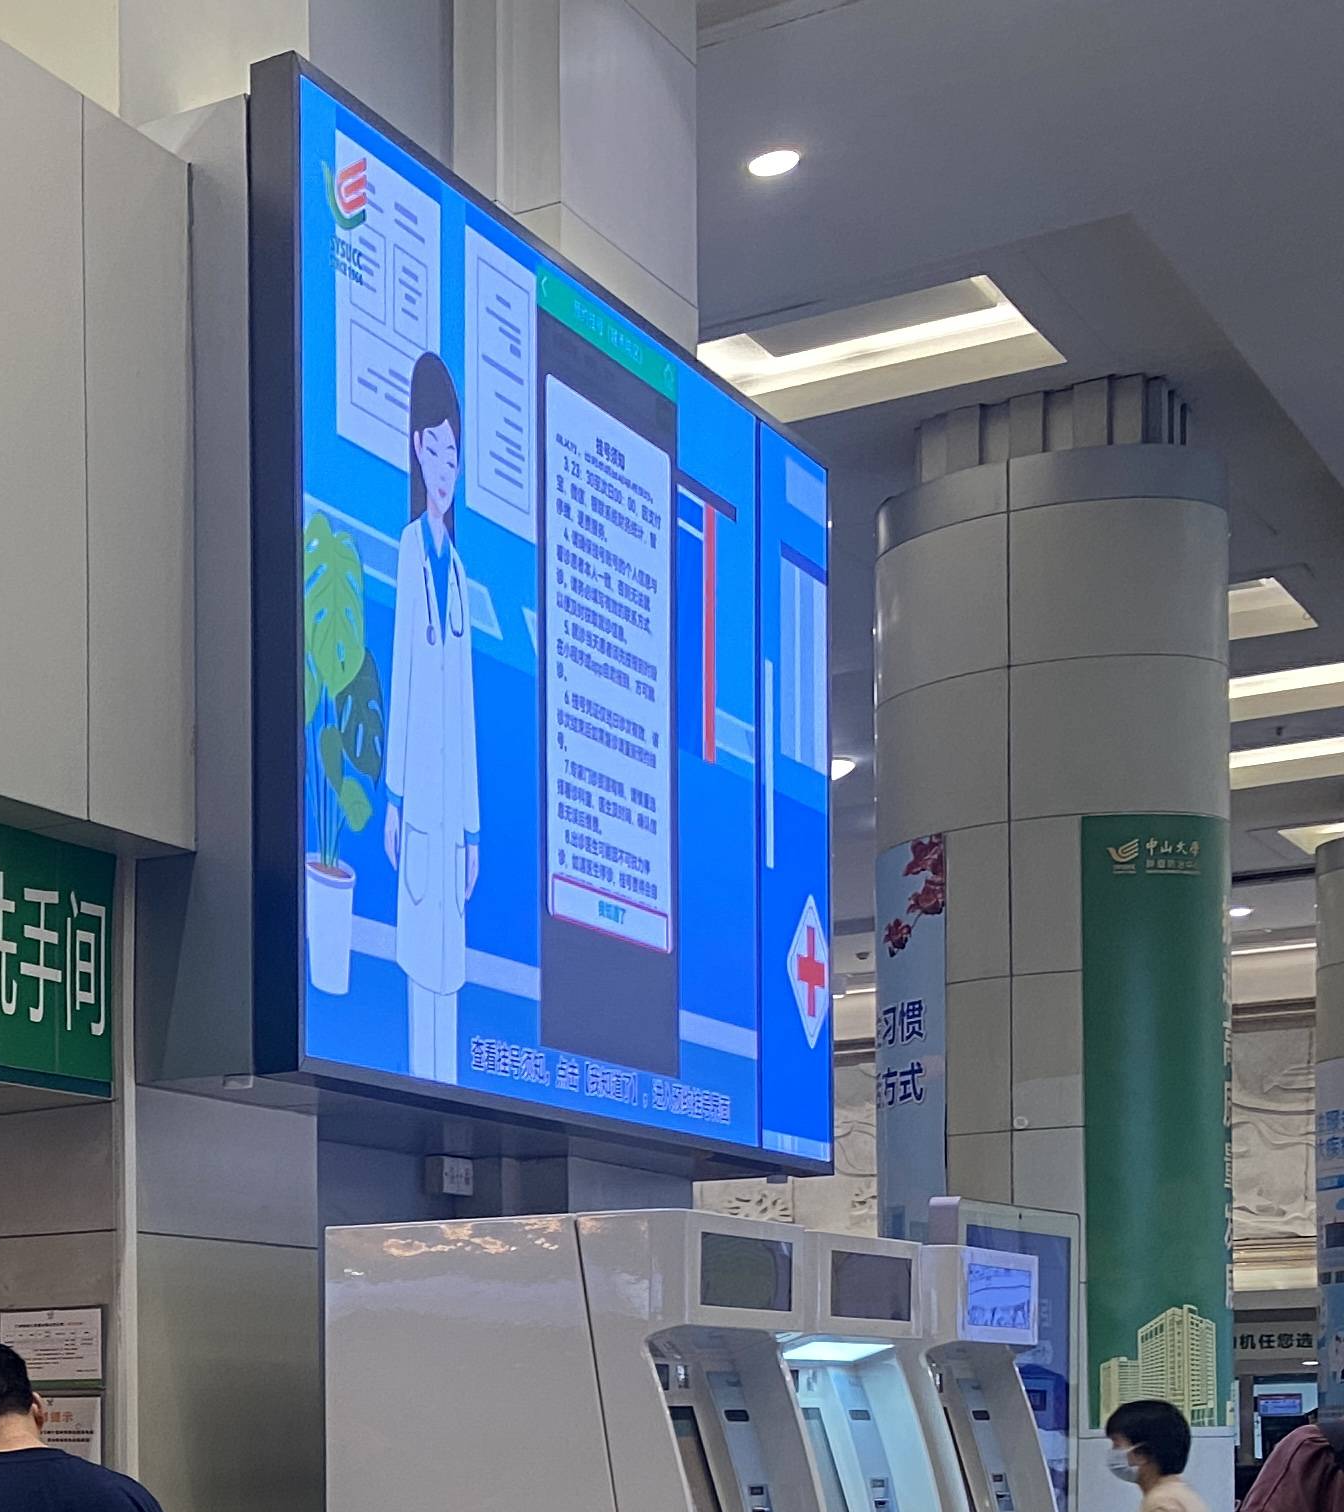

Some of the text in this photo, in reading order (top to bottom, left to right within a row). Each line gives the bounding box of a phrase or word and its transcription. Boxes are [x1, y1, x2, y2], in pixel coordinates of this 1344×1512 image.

[330, 236, 362, 270] SYSUCC
[876, 999, 925, 1047] 习惯
[1233, 1332, 1314, 1350] 机任您选
